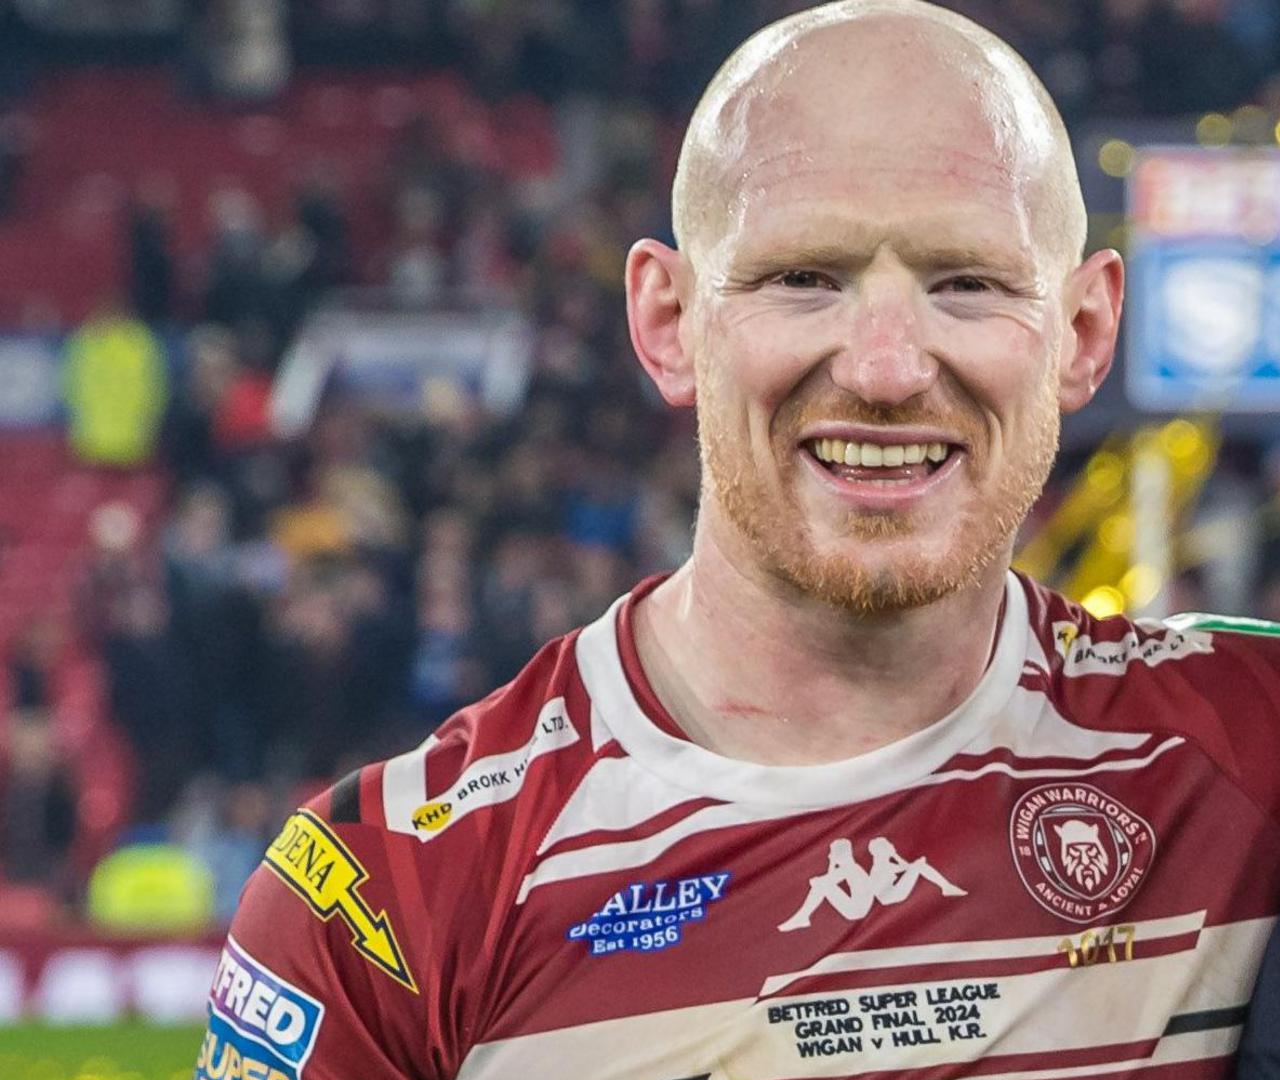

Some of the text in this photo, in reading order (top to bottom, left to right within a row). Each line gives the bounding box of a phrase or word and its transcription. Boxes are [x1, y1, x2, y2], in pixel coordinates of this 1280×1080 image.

[411, 802, 452, 830] KHD
[1017, 787, 1141, 840] WIGAN WARRIORS
[1035, 882, 1092, 916] ANCIENT
[1110, 867, 1144, 903] LOYAL
[768, 983, 1001, 1024] BETFRED SUPER LEAGUE
[795, 1004, 981, 1039] GRAND FINAL 2024
[797, 1038, 862, 1058] WIGAN
[892, 1029, 941, 1048] HULL
